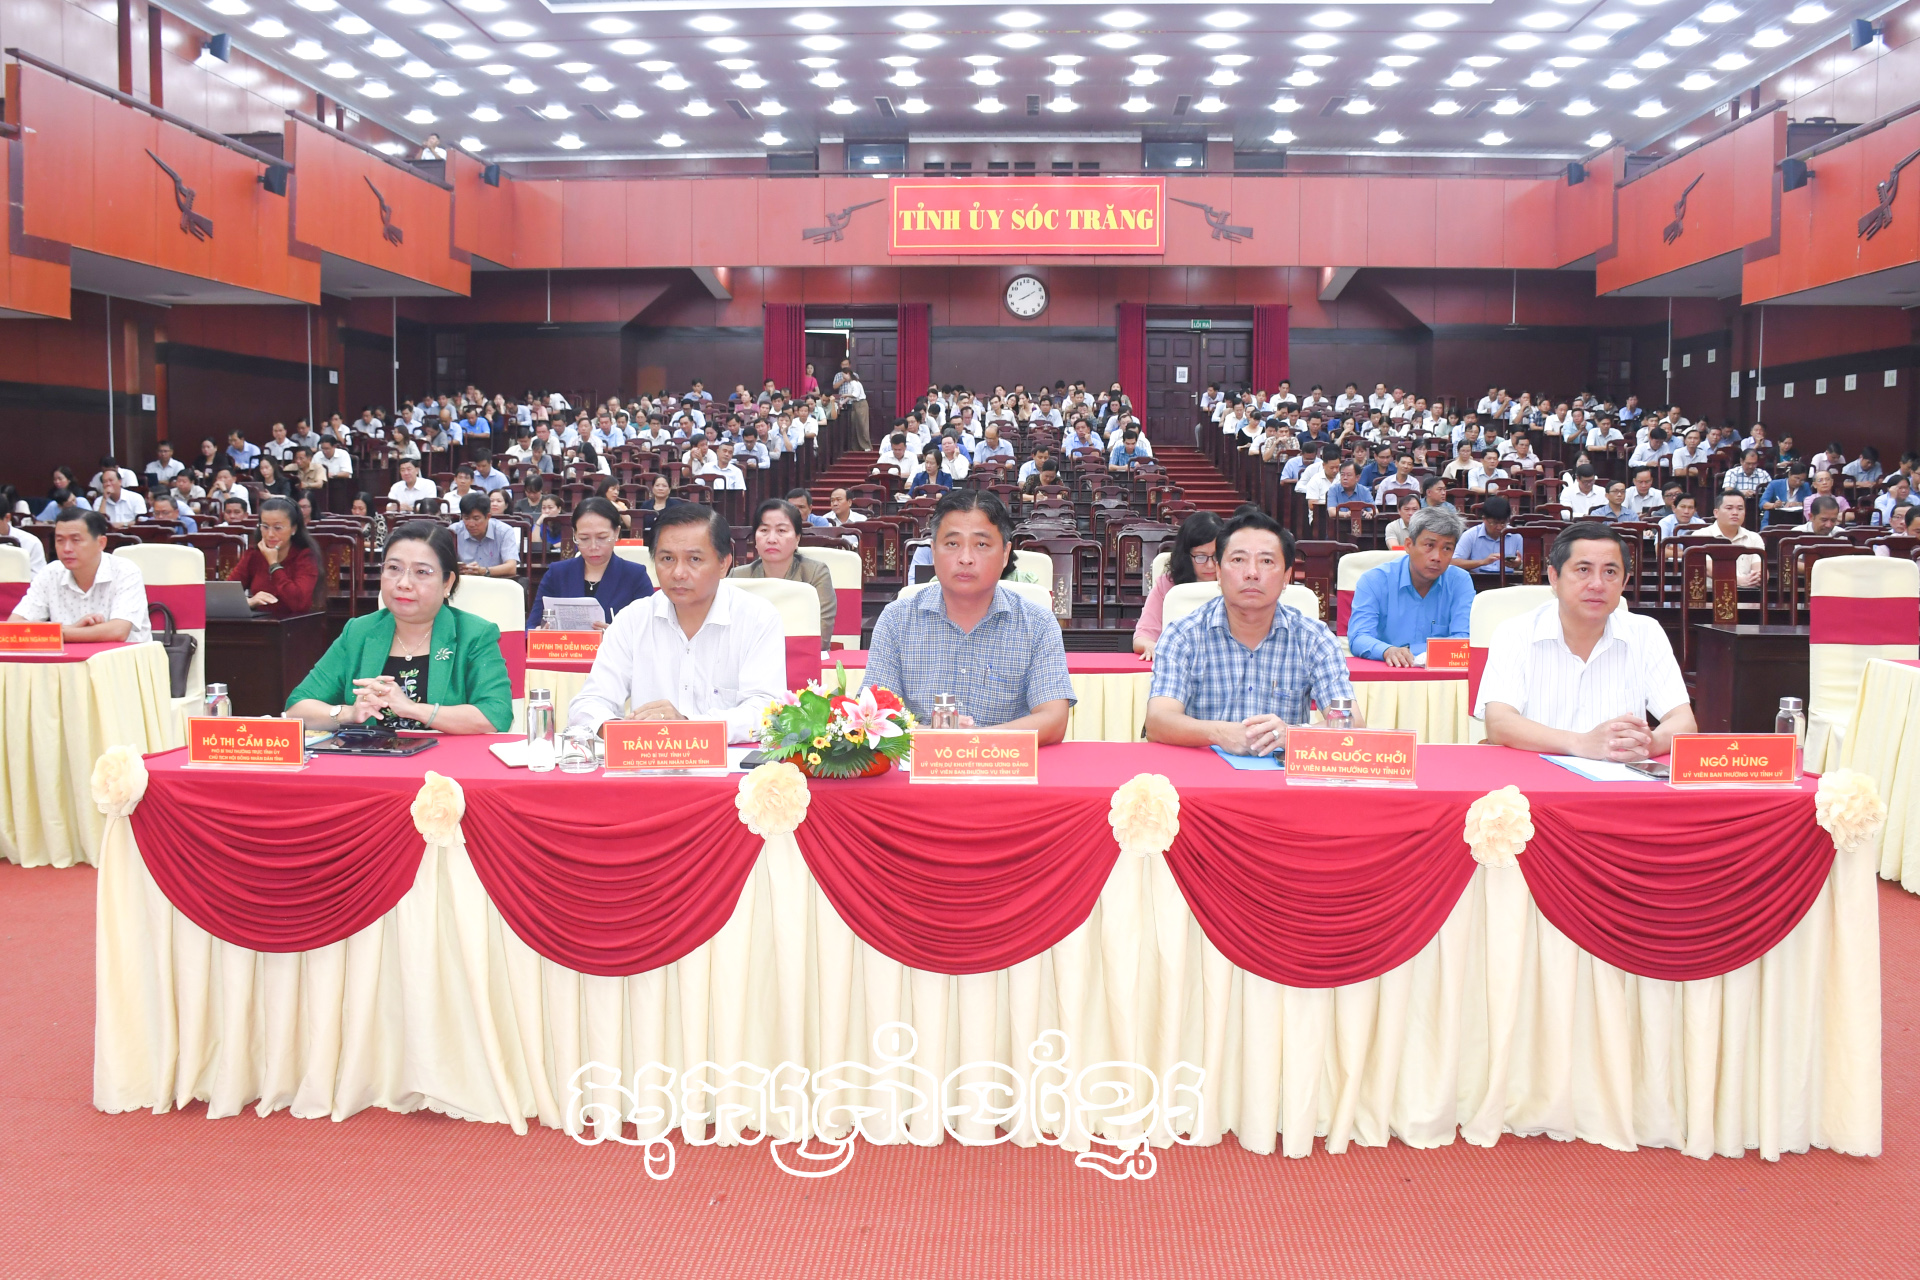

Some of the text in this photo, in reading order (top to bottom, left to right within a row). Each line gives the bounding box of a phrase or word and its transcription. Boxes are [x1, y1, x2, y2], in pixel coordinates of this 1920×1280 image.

[899, 202, 1154, 230] TỈNH ỦY SÓC TRĂNG
[203, 734, 217, 746] HỒ
[220, 737, 235, 748] THỊ
[266, 736, 289, 747] ĐÀO
[623, 736, 709, 750] TRẦN VĂN LÂU
[935, 747, 1020, 759] VÕ CHÍ CÔNG
[1295, 747, 1406, 763] TRẦN QUỐC KHỞI
[1700, 754, 1769, 767] NGÔ HÙNG
[1290, 762, 1300, 771] ỦY
[1339, 766, 1368, 774] THƯỜNG
[1400, 767, 1411, 775] ỦY
